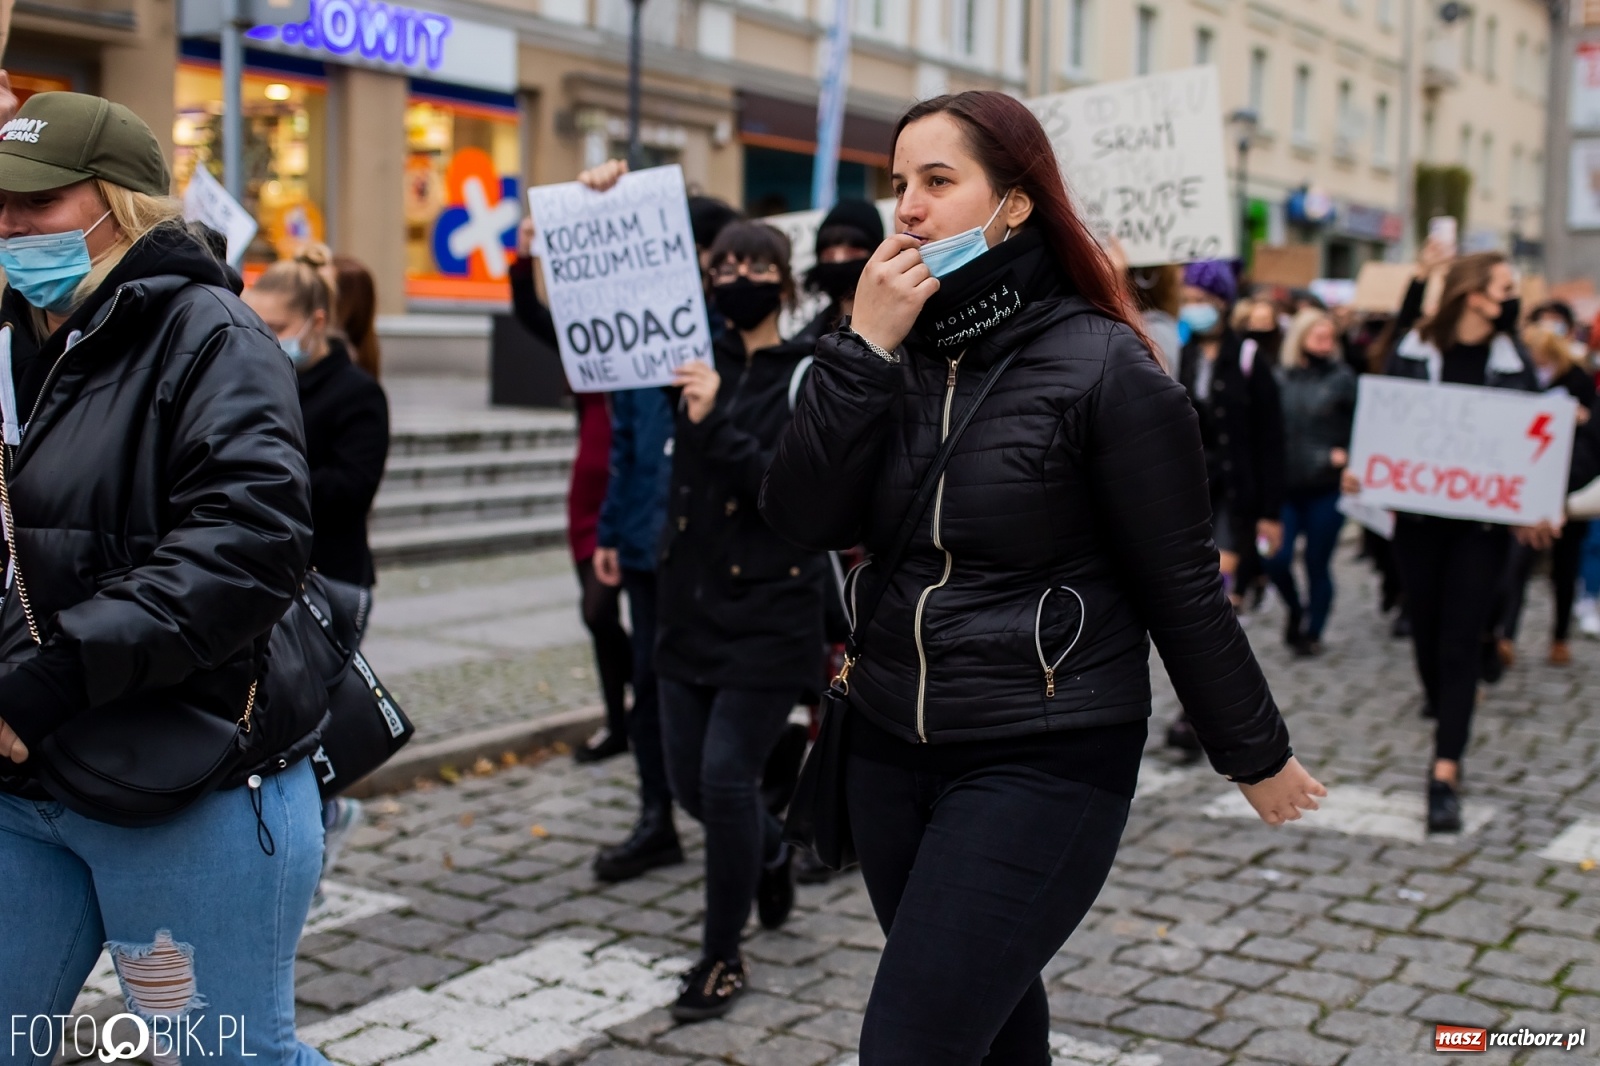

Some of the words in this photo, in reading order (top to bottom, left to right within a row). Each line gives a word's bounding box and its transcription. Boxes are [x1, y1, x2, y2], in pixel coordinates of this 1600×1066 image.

[1114, 176, 1204, 214] DUPE
[543, 211, 646, 256] KOCHAM
[657, 206, 669, 234] I
[550, 231, 688, 285] ROZUMIEM
[566, 298, 697, 355] ODDAĆ
[936, 285, 1009, 331] FASHION
[577, 355, 620, 387] NIE
